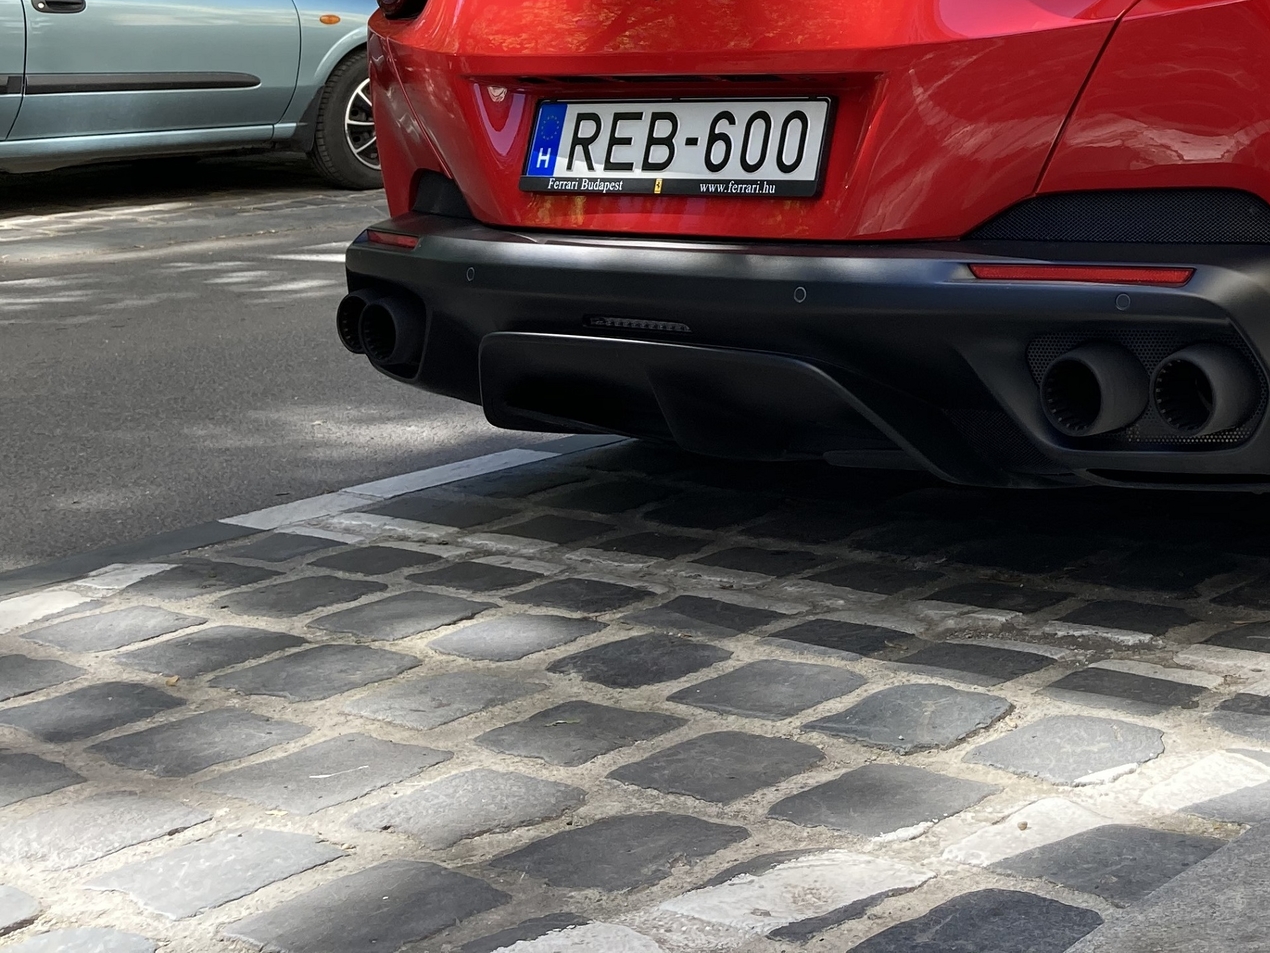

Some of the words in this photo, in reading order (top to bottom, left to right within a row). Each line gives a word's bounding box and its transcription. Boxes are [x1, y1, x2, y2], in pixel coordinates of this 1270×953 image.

[566, 110, 808, 174] REB-600
[536, 148, 551, 169] H
[547, 178, 579, 190] Ferrari
[580, 178, 624, 193] Budapest
[699, 180, 776, 194] www.ferrari.hu
